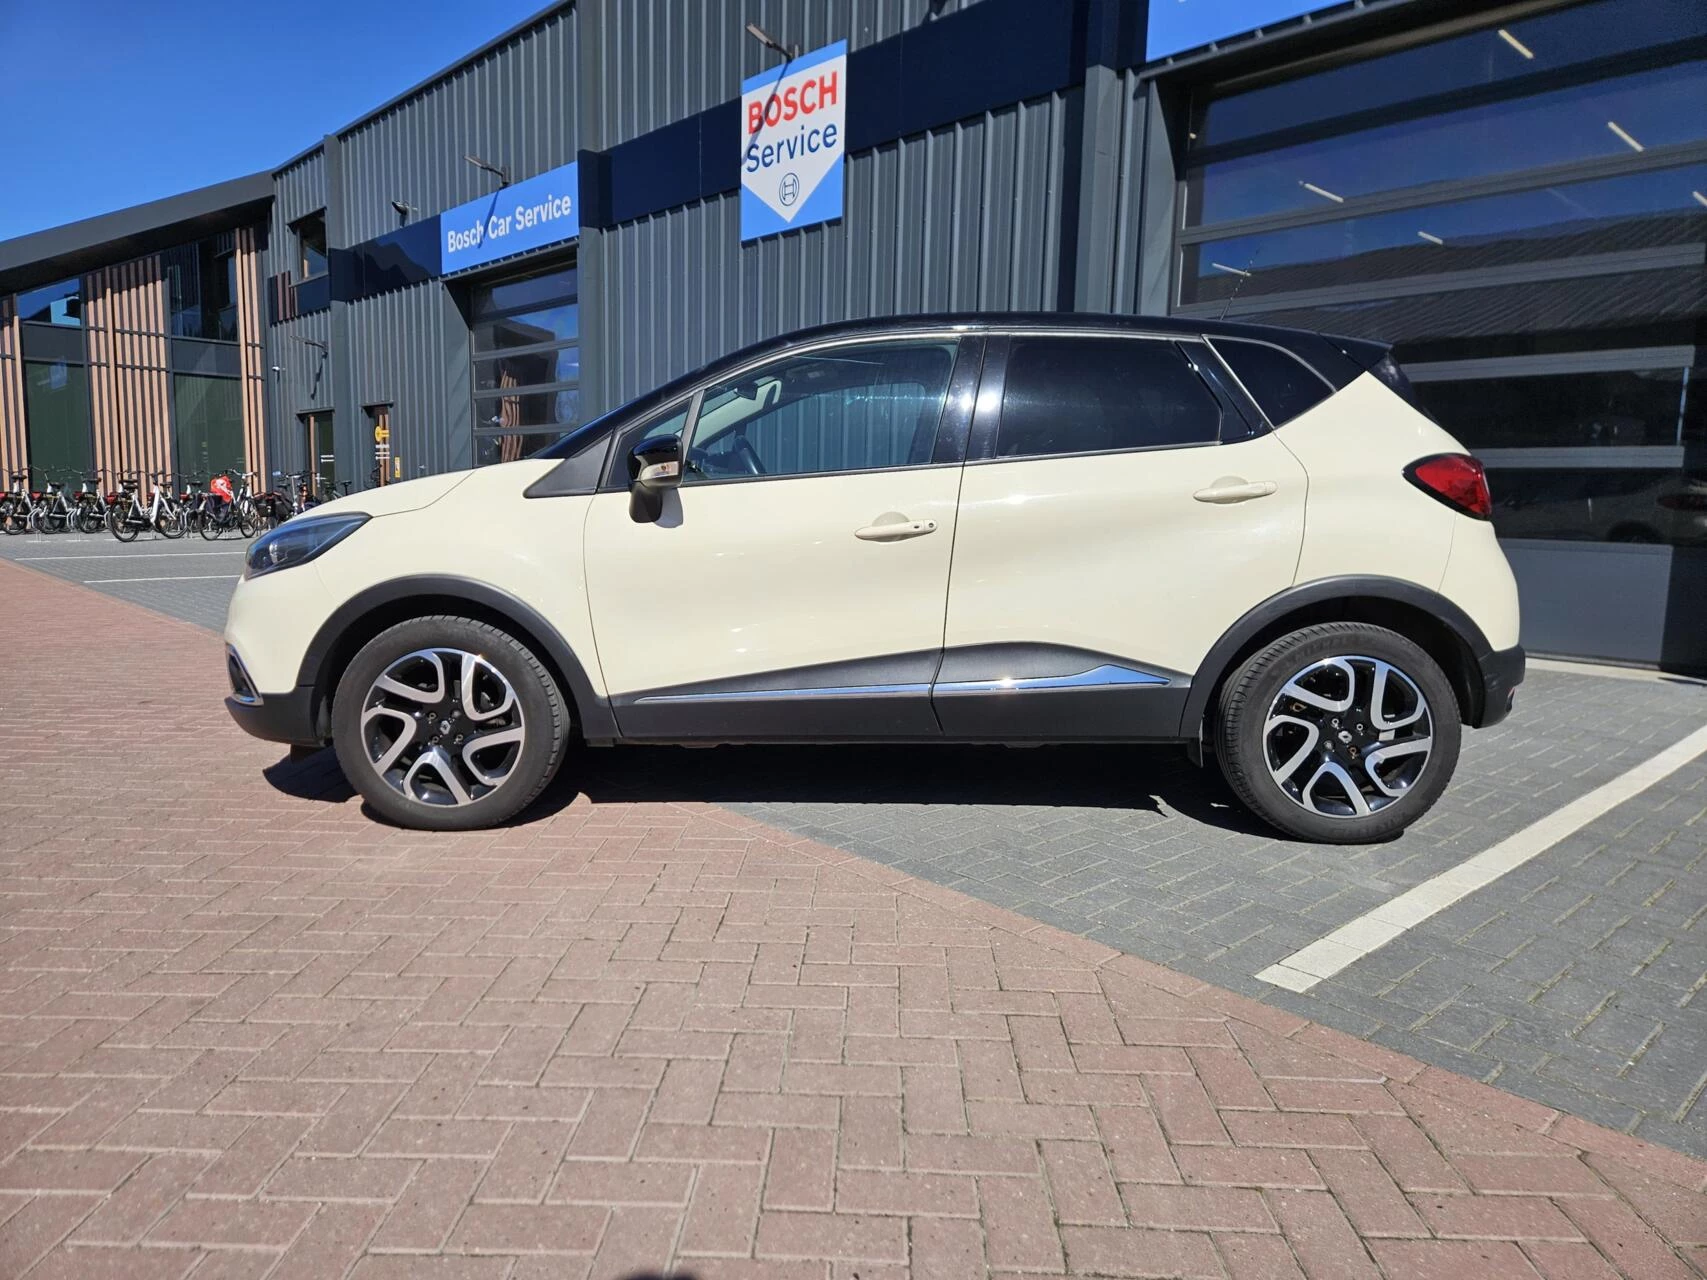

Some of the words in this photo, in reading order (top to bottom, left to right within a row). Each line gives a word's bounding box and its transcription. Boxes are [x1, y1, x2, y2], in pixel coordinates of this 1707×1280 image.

[748, 71, 838, 134] BOSCH
[746, 123, 837, 172] Service
[448, 220, 484, 253] Bosch
[488, 214, 512, 239] Car
[515, 194, 571, 231] Service
